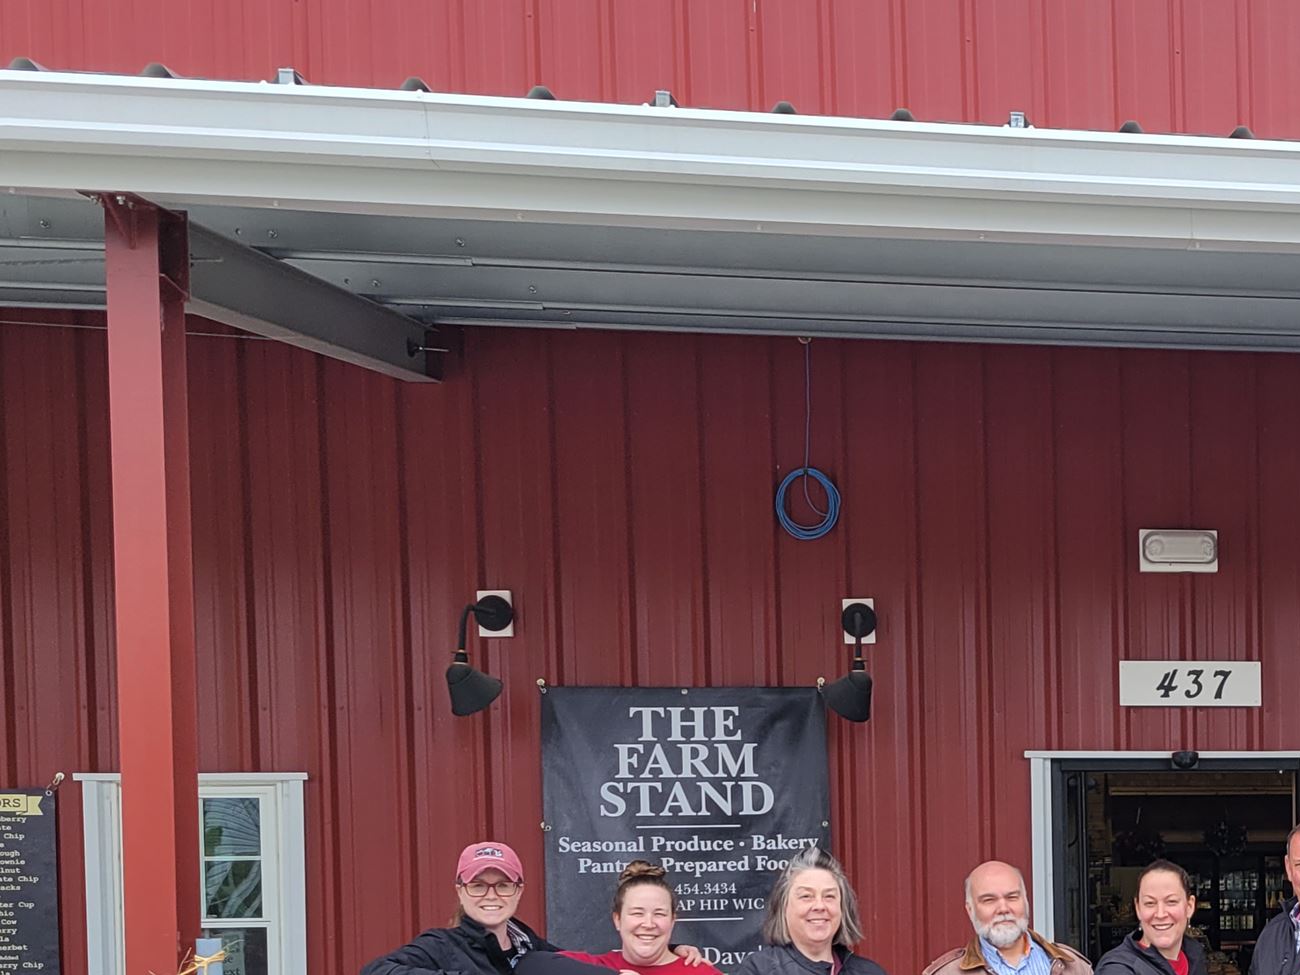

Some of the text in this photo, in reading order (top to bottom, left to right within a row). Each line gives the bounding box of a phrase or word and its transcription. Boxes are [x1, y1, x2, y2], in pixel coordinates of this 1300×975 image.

[1156, 669, 1232, 699] 437
[629, 706, 742, 741] THE
[614, 743, 759, 778] FARM
[0, 799, 21, 808] RS
[600, 781, 775, 817] STAND
[558, 834, 819, 853] Seasonal Produce Bakery
[578, 856, 790, 877] Pantr Prepared Foo
[700, 899, 728, 910] HIP
[734, 898, 765, 910] WIC
